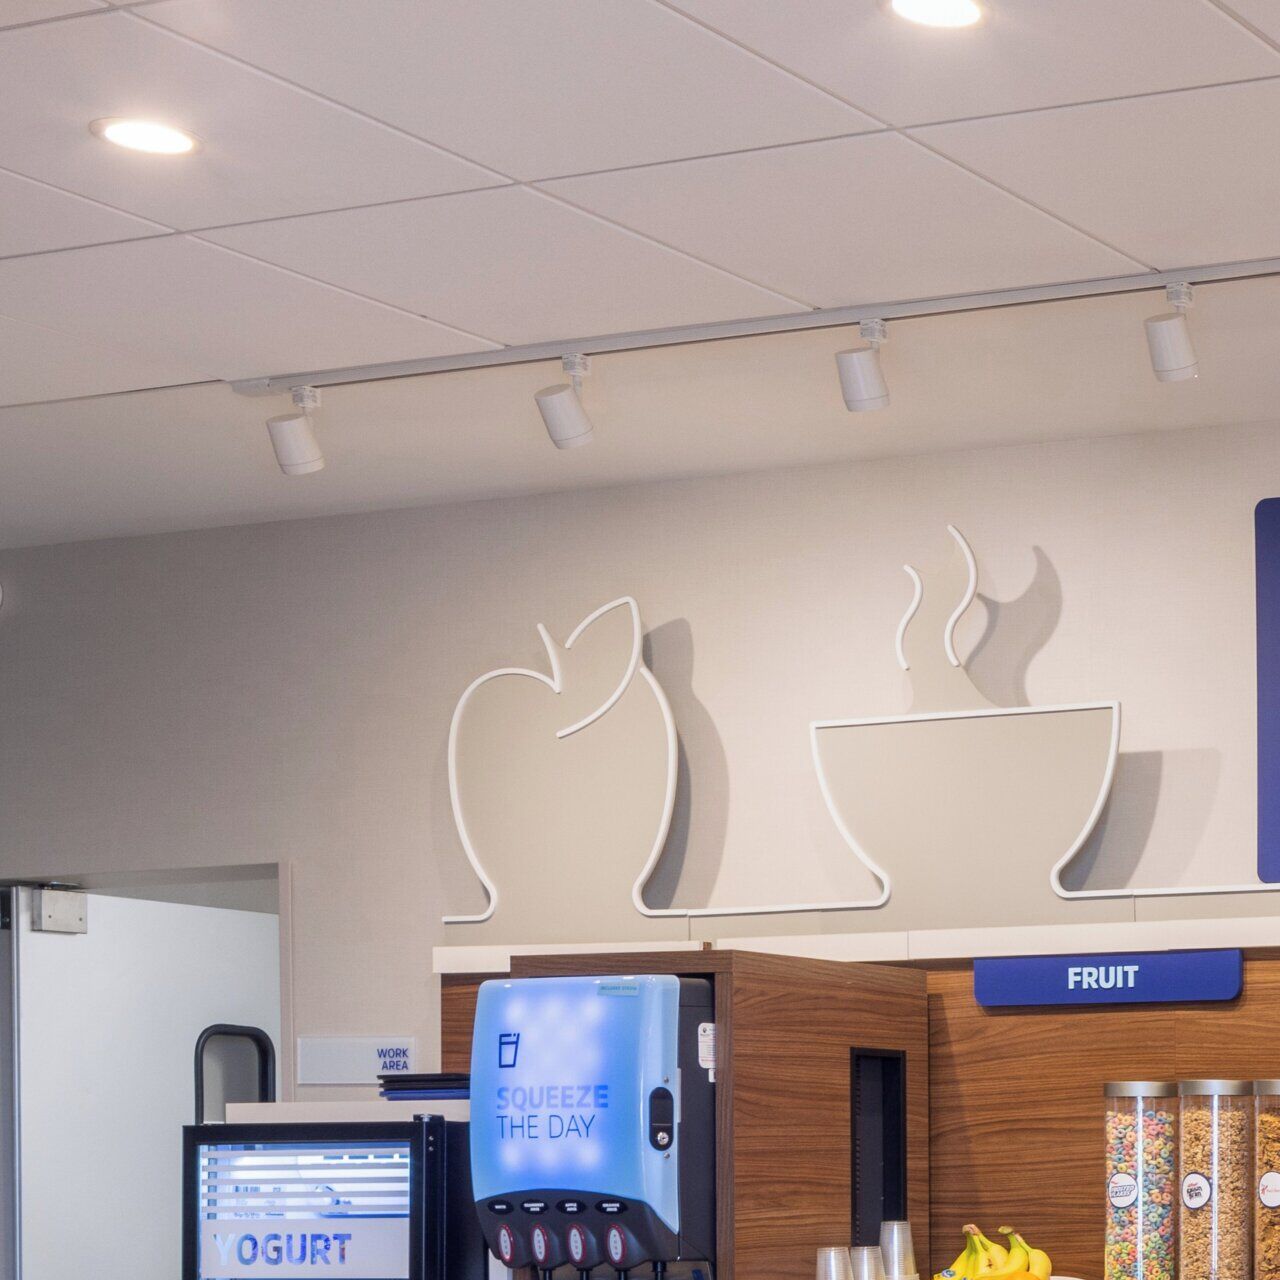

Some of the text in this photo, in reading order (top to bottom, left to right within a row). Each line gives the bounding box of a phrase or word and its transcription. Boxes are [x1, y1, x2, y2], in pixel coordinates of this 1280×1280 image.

[1067, 965, 1139, 990] FRUIT
[376, 1048, 409, 1059] WORK
[381, 1060, 409, 1070] AREA
[496, 1084, 609, 1111] SQUEEZE
[496, 1114, 596, 1139] THE DAY
[213, 1232, 352, 1266] YOGURT
